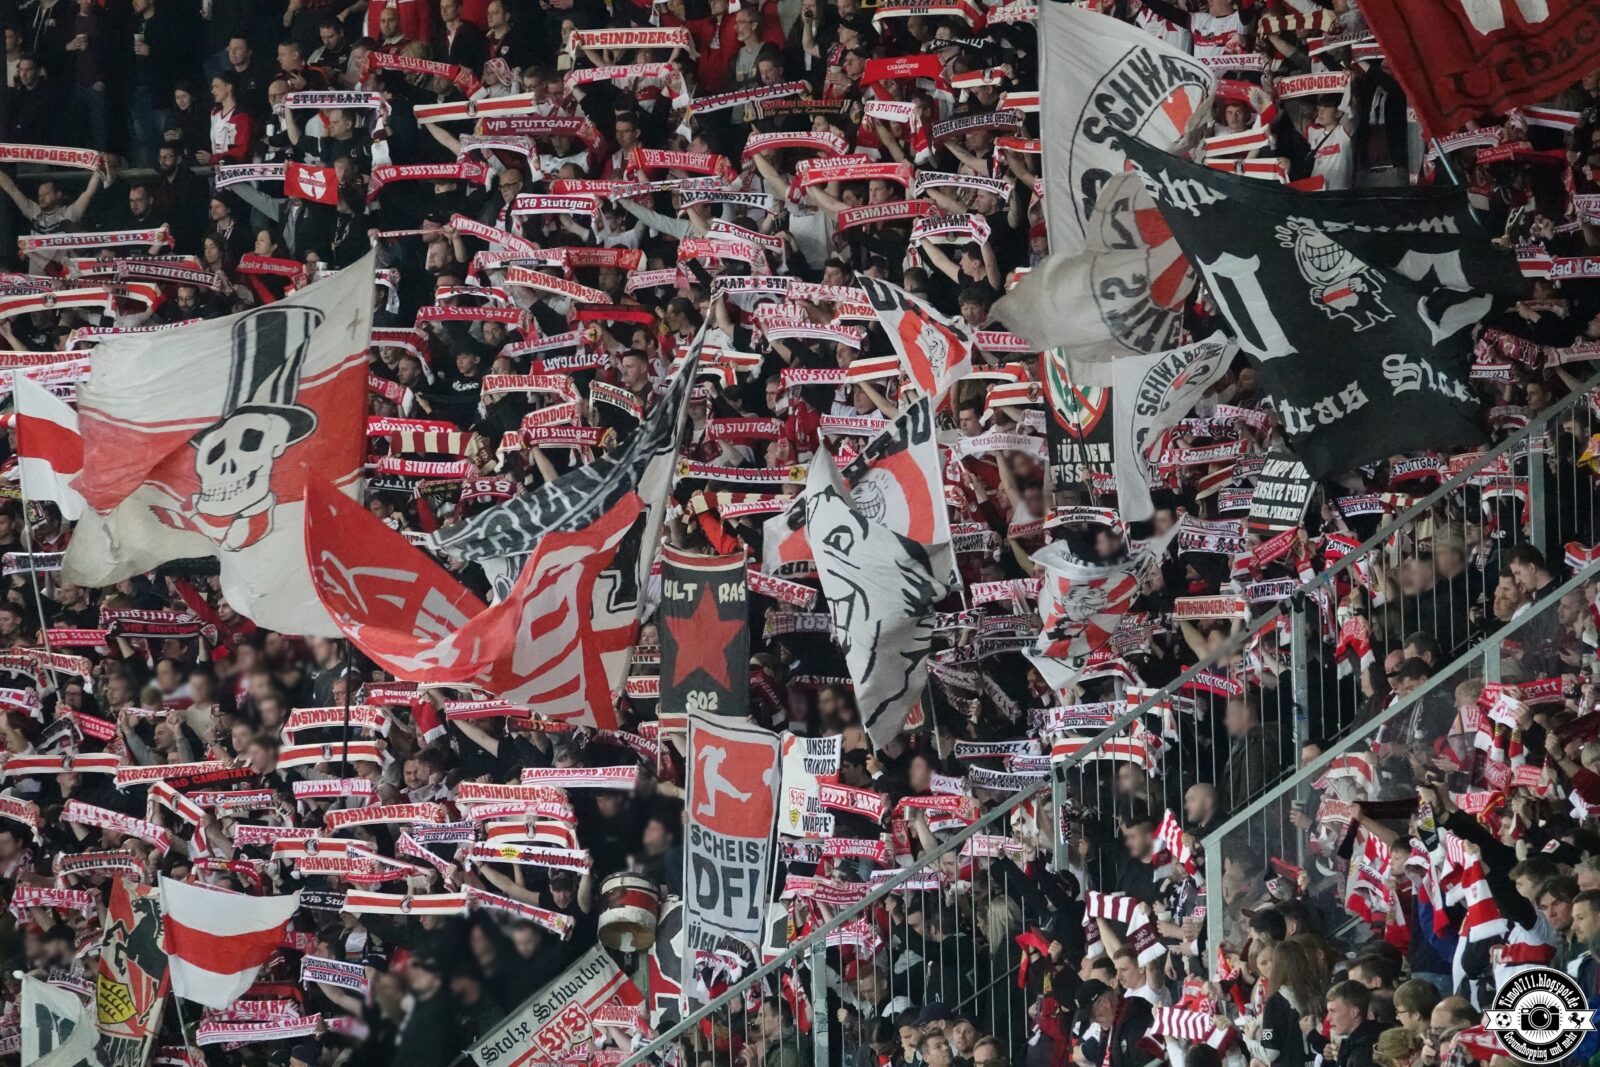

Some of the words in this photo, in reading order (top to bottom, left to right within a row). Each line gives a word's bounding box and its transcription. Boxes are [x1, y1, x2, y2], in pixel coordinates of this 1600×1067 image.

[600, 32, 634, 45] SIND
[638, 31, 667, 44] DER
[374, 53, 396, 66] VfB
[398, 55, 450, 74] STUTTGART
[886, 62, 919, 71] CHAMPIONS
[1289, 77, 1313, 91] SIND
[1316, 75, 1336, 89] DER
[292, 93, 372, 105] STUTTGART
[486, 120, 508, 131] VfB
[510, 118, 581, 130] STUTTGART
[12, 148, 44, 161] SIND
[664, 152, 709, 168] STUTTGART
[399, 164, 459, 177] STUTTGART
[564, 181, 582, 192] VfB
[516, 198, 536, 208] VfB
[845, 203, 909, 223] LEHMANN
[920, 215, 971, 232] STUTTGART
[153, 266, 213, 284] STUTTGART
[531, 271, 559, 289] SIND
[562, 279, 582, 294] DER
[417, 307, 445, 318] VfB
[449, 306, 514, 319] Stuttgart
[22, 353, 53, 366] SIND
[498, 376, 529, 389] SIND
[527, 427, 548, 437] VfB
[551, 427, 597, 440] Stuttgart
[382, 458, 401, 471] VfB
[405, 459, 464, 475] STUTTGART
[691, 462, 783, 482] STUTTGART
[1397, 457, 1445, 475] STUTTGART
[1284, 478, 1308, 503] FÜR
[71, 631, 104, 640] Stutt
[637, 680, 660, 694] SIN
[299, 709, 326, 724] SIND
[806, 738, 836, 756] UNSERE
[803, 757, 836, 776] TRIKOTS
[458, 784, 481, 798] WIR
[484, 785, 511, 799] SIND
[514, 786, 536, 800] DER
[349, 805, 382, 822] SIND
[386, 804, 416, 819] DER
[691, 824, 766, 864] SCHEIS
[307, 857, 330, 871] SIND
[481, 1021, 532, 1066] Stolze
[532, 953, 610, 1025] Schwaben
